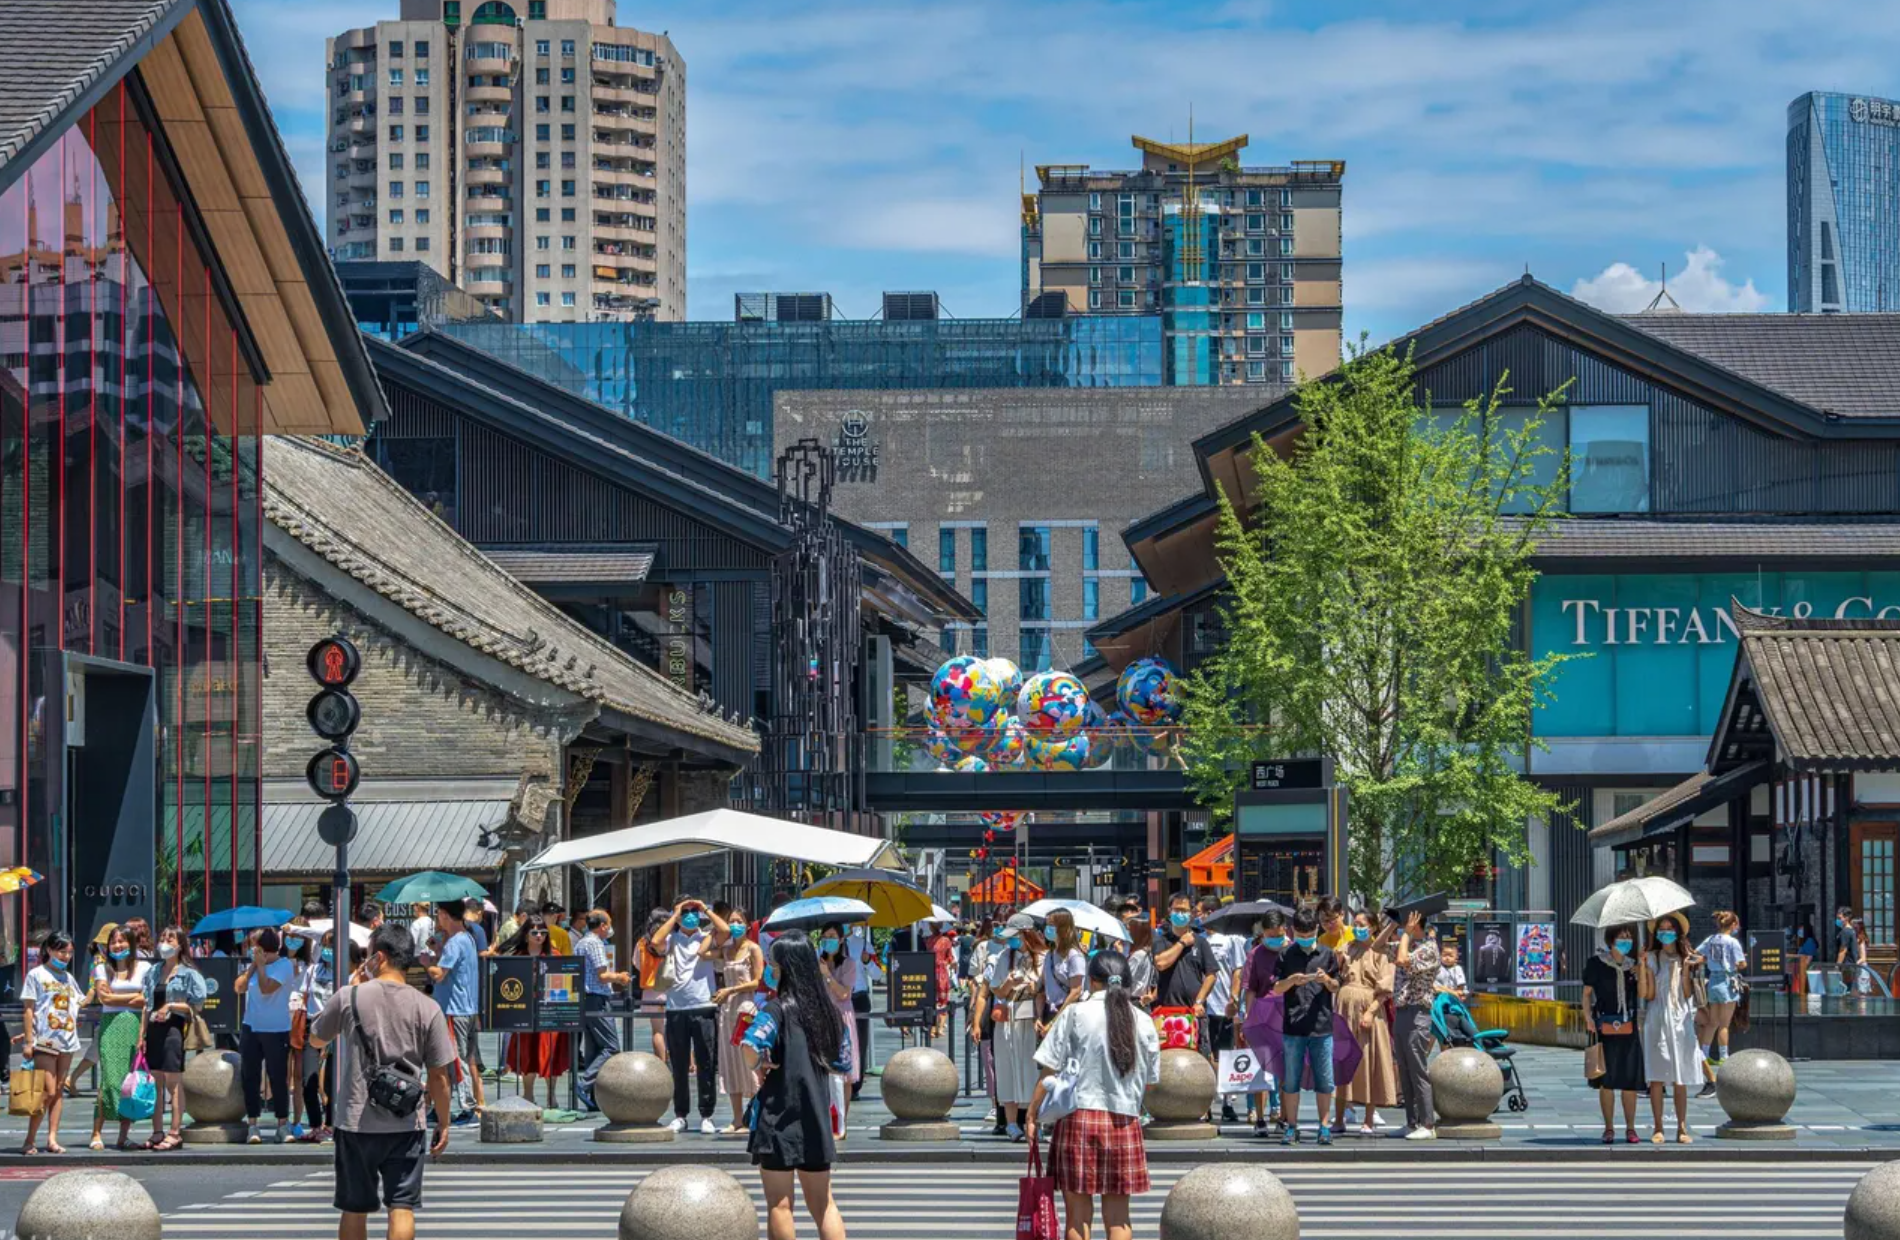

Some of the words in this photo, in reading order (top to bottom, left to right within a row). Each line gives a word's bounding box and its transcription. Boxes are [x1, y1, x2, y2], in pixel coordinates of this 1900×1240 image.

[846, 438, 867, 447] THE
[832, 446, 879, 456] TEMPLE
[1562, 599, 1782, 645] TIFFAN
[84, 884, 147, 897] GUCCI
[1229, 1073, 1254, 1083] Aape
